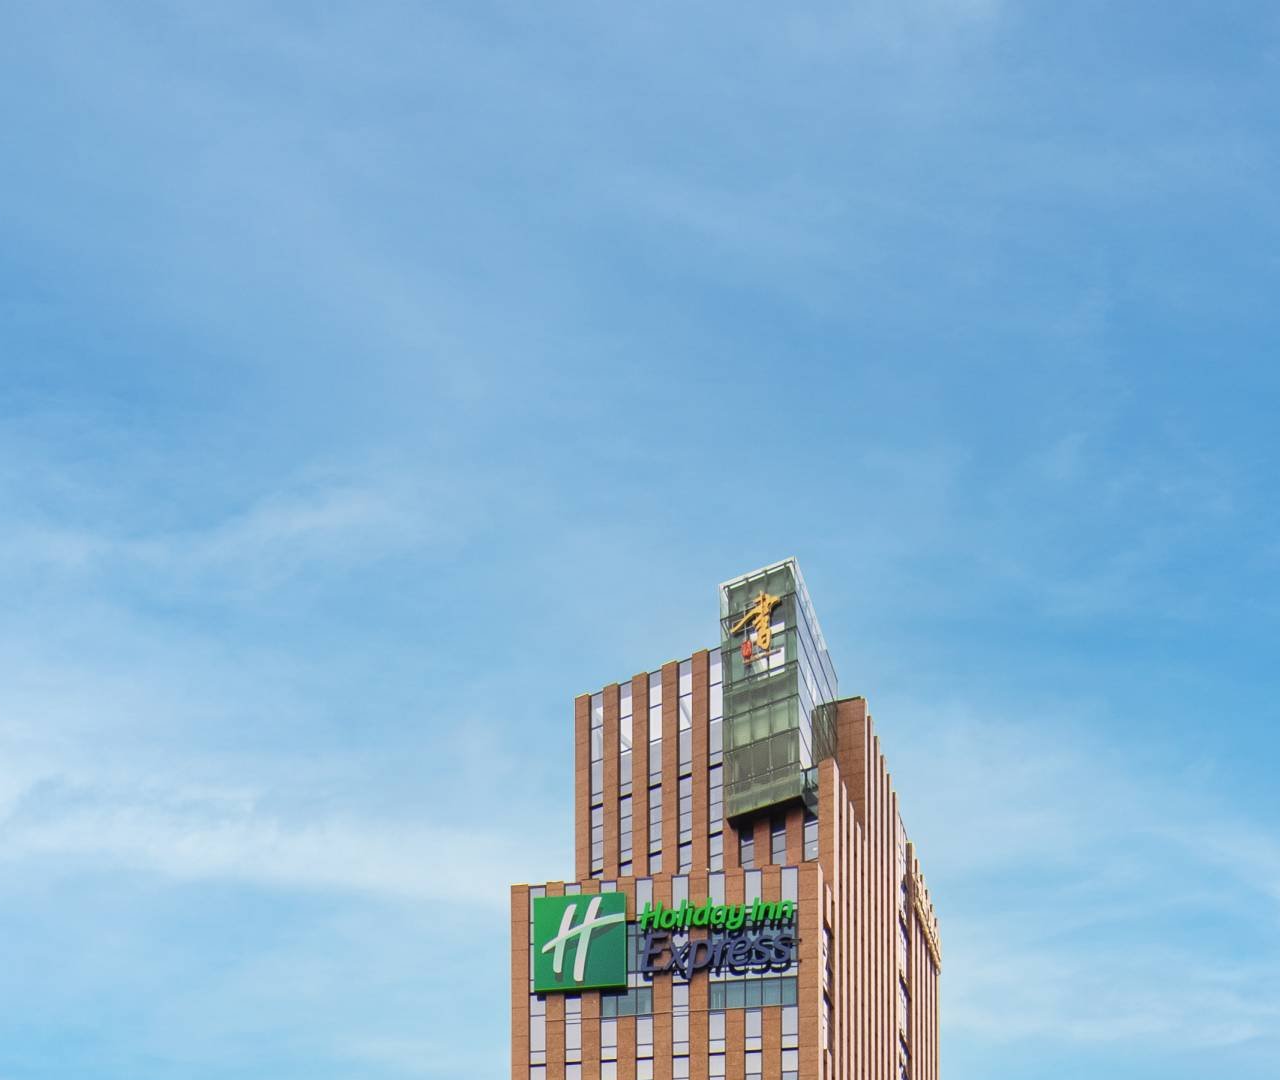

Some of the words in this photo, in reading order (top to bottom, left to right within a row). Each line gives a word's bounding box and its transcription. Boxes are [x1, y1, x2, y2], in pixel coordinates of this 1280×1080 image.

[640, 897, 745, 930] Holiday
[751, 896, 794, 922] Inn
[640, 931, 794, 980] Express
